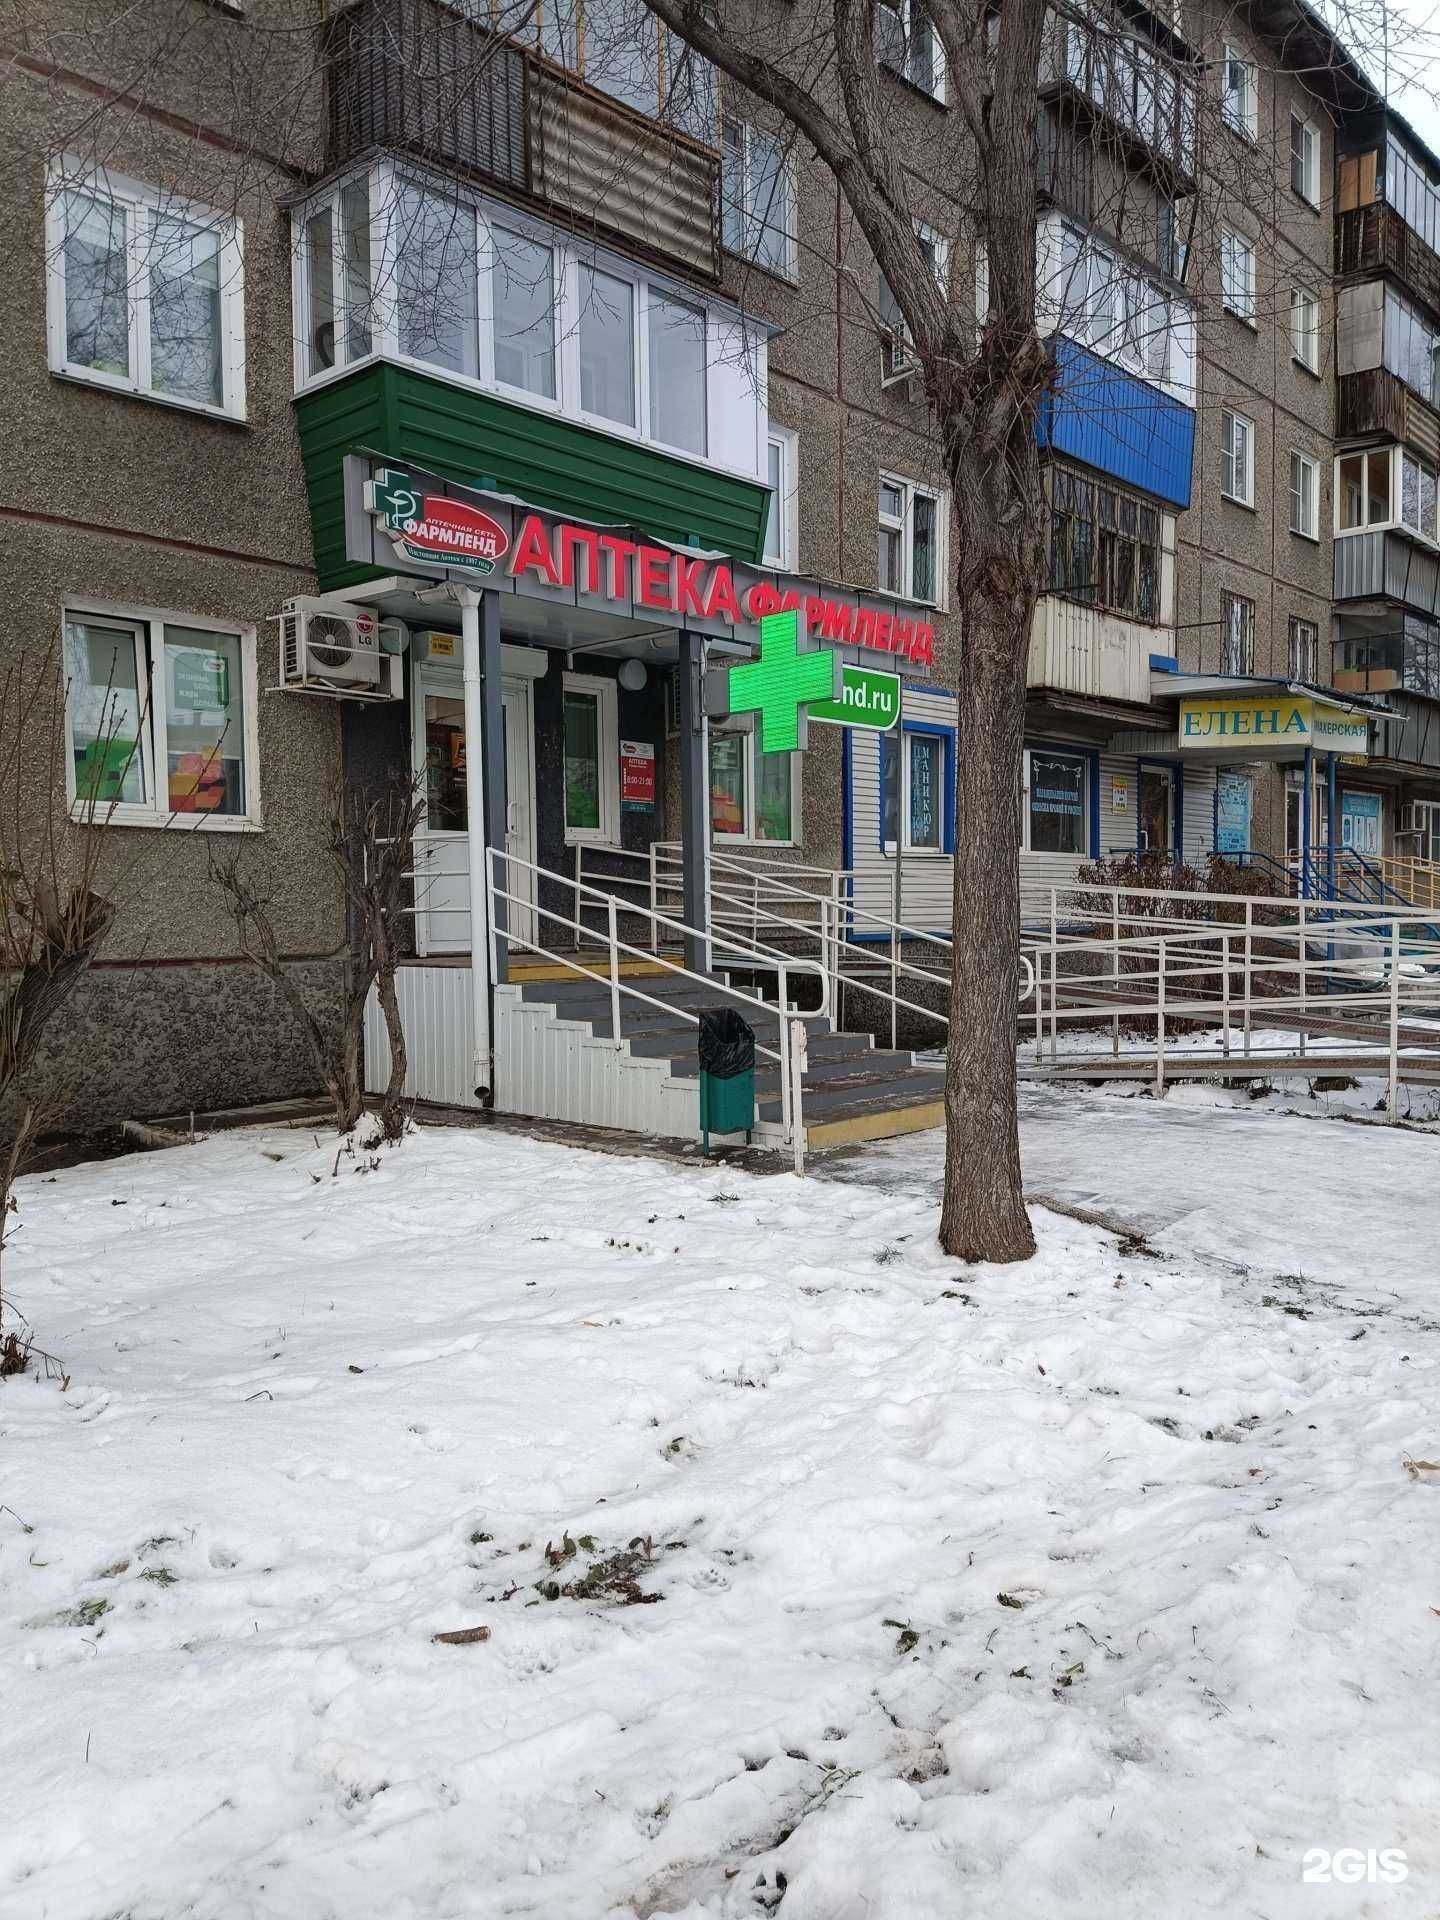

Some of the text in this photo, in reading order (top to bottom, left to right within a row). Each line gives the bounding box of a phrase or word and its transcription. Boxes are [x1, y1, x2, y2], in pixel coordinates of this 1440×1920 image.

[402, 517, 497, 557] ФАРМЛЕНД
[425, 517, 497, 539] АПТЕЧНАЯ СЕТЬ
[508, 514, 743, 625] АПТЕКА
[358, 634, 372, 646] LG
[832, 681, 892, 712] nd.ru
[1183, 708, 1309, 737] ЕЛЕНА
[922, 746, 932, 838] МАНИКЮР
